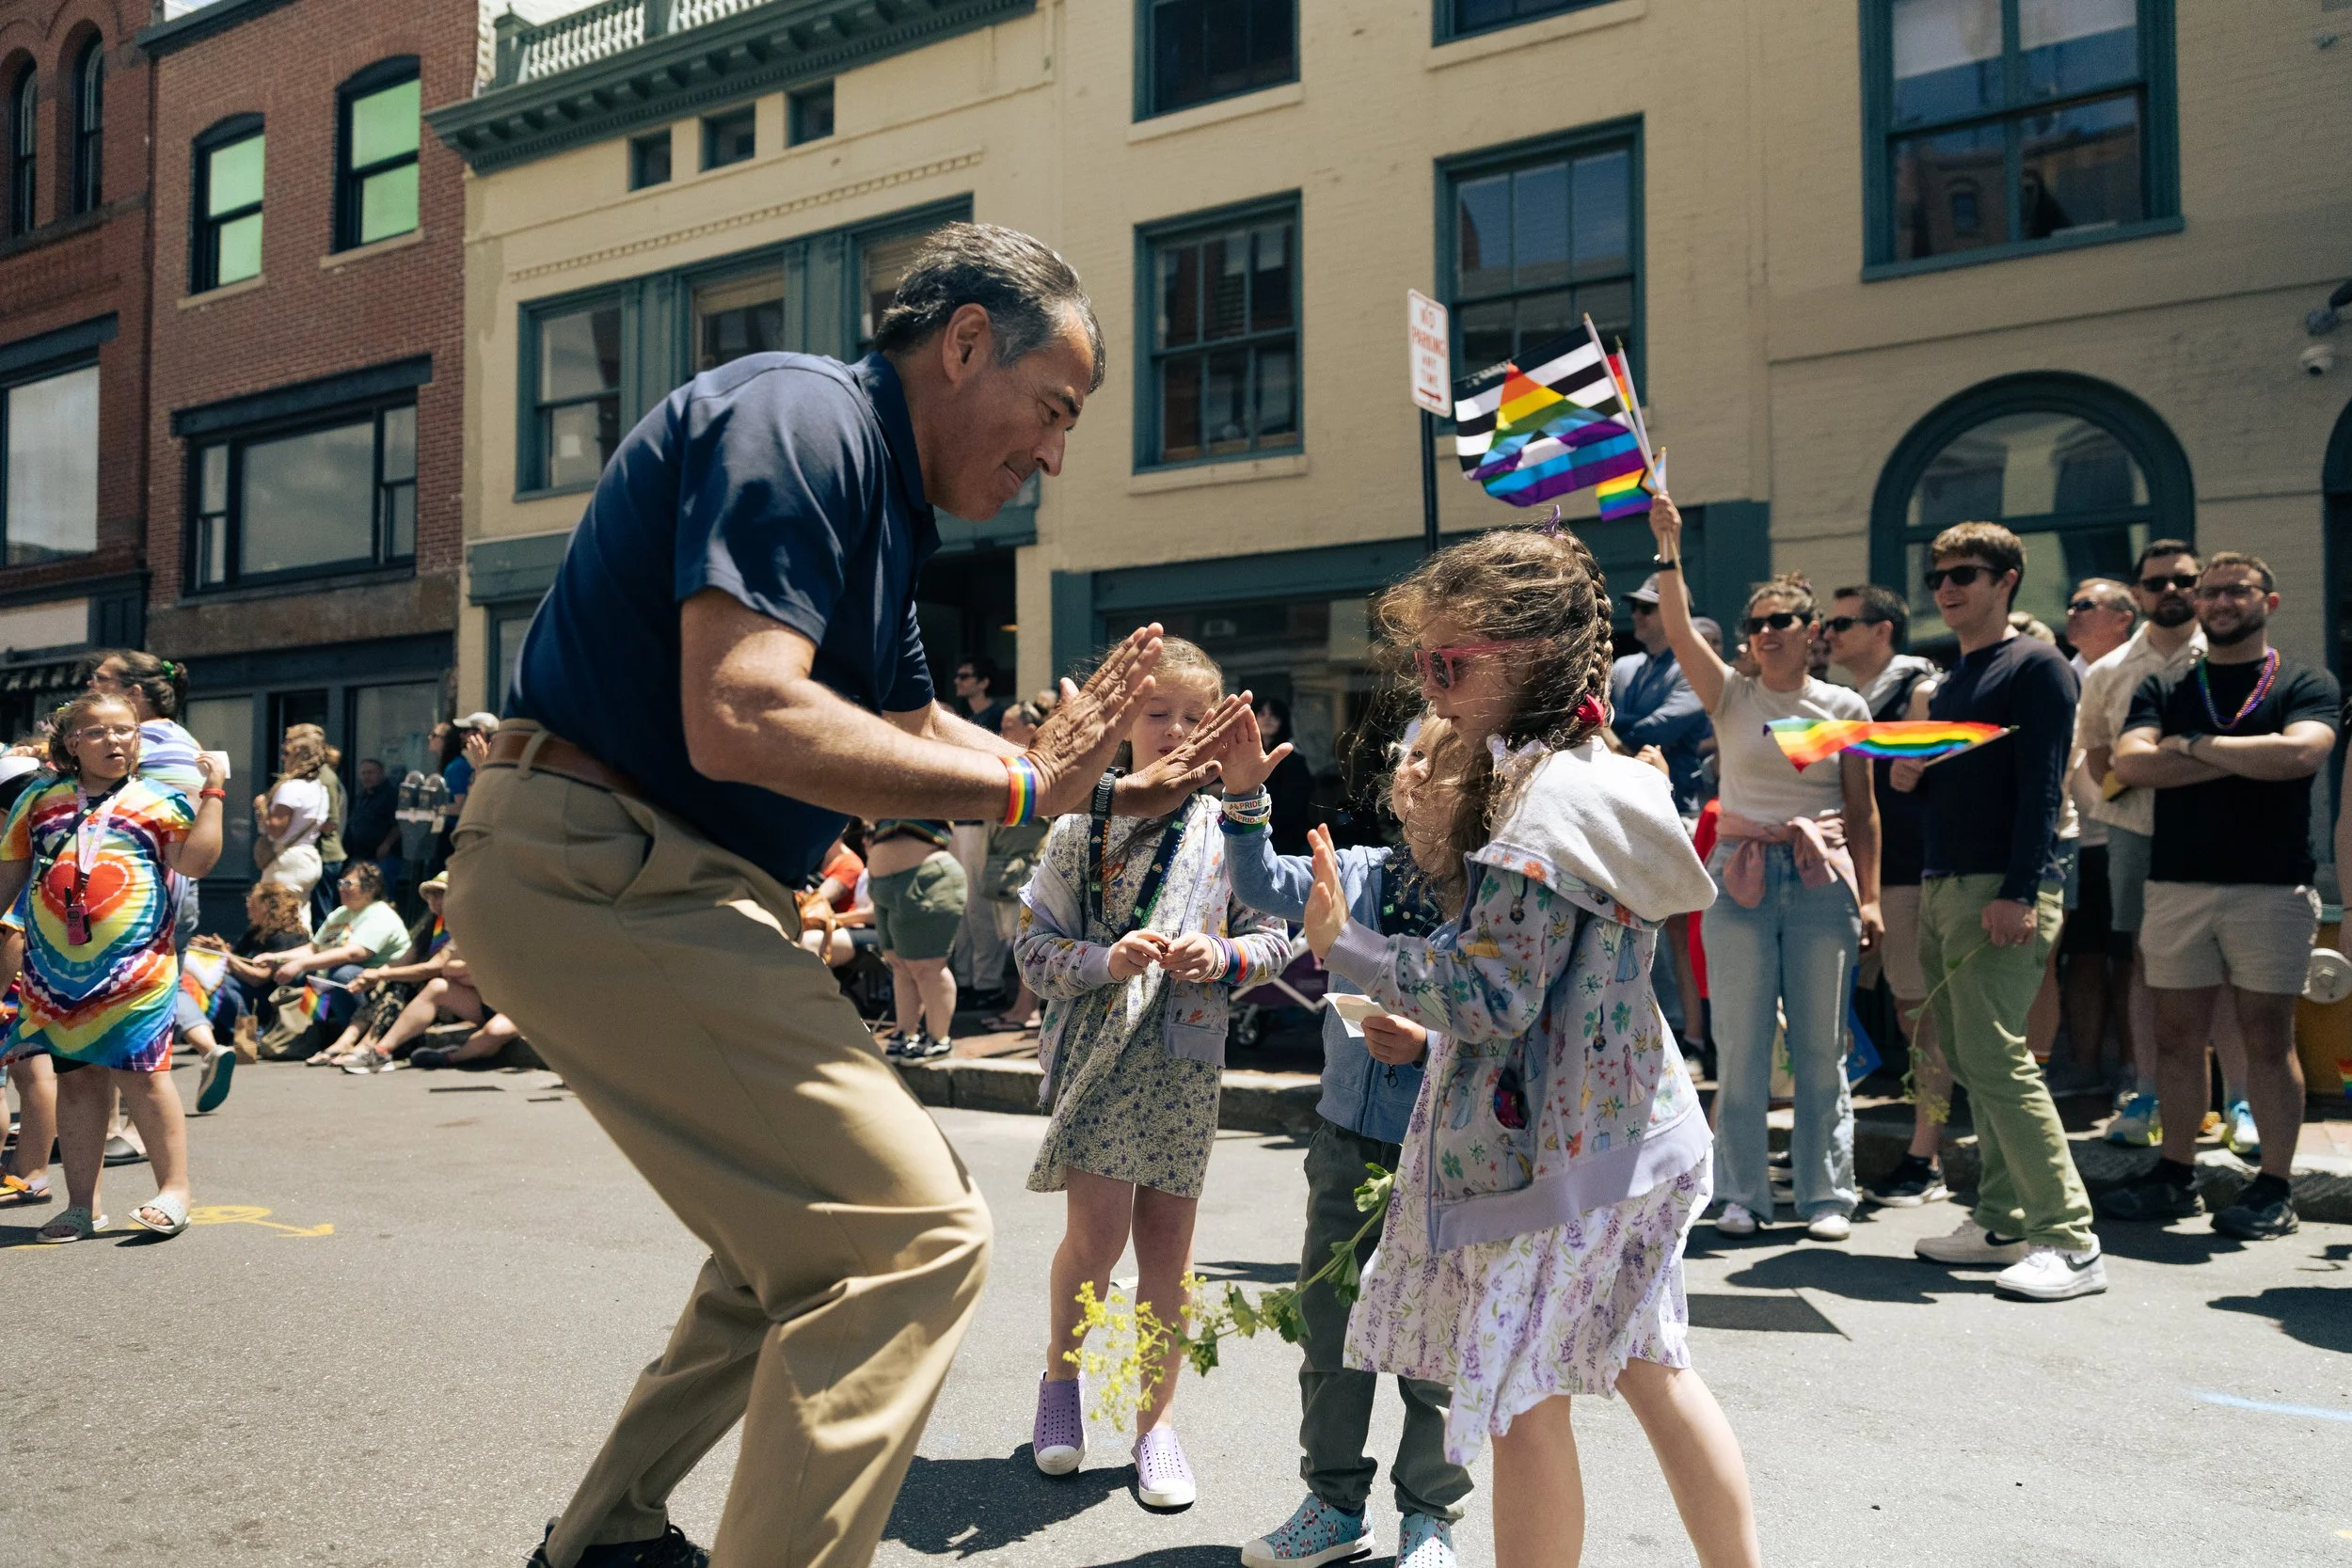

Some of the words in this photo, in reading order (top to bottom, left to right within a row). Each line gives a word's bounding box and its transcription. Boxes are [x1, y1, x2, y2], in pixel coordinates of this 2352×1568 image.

[1420, 309, 1436, 329] NO
[1412, 325, 1446, 357] PARKING
[1239, 800, 1262, 810] PRIDE
[1237, 815, 1261, 823] PRIDE
